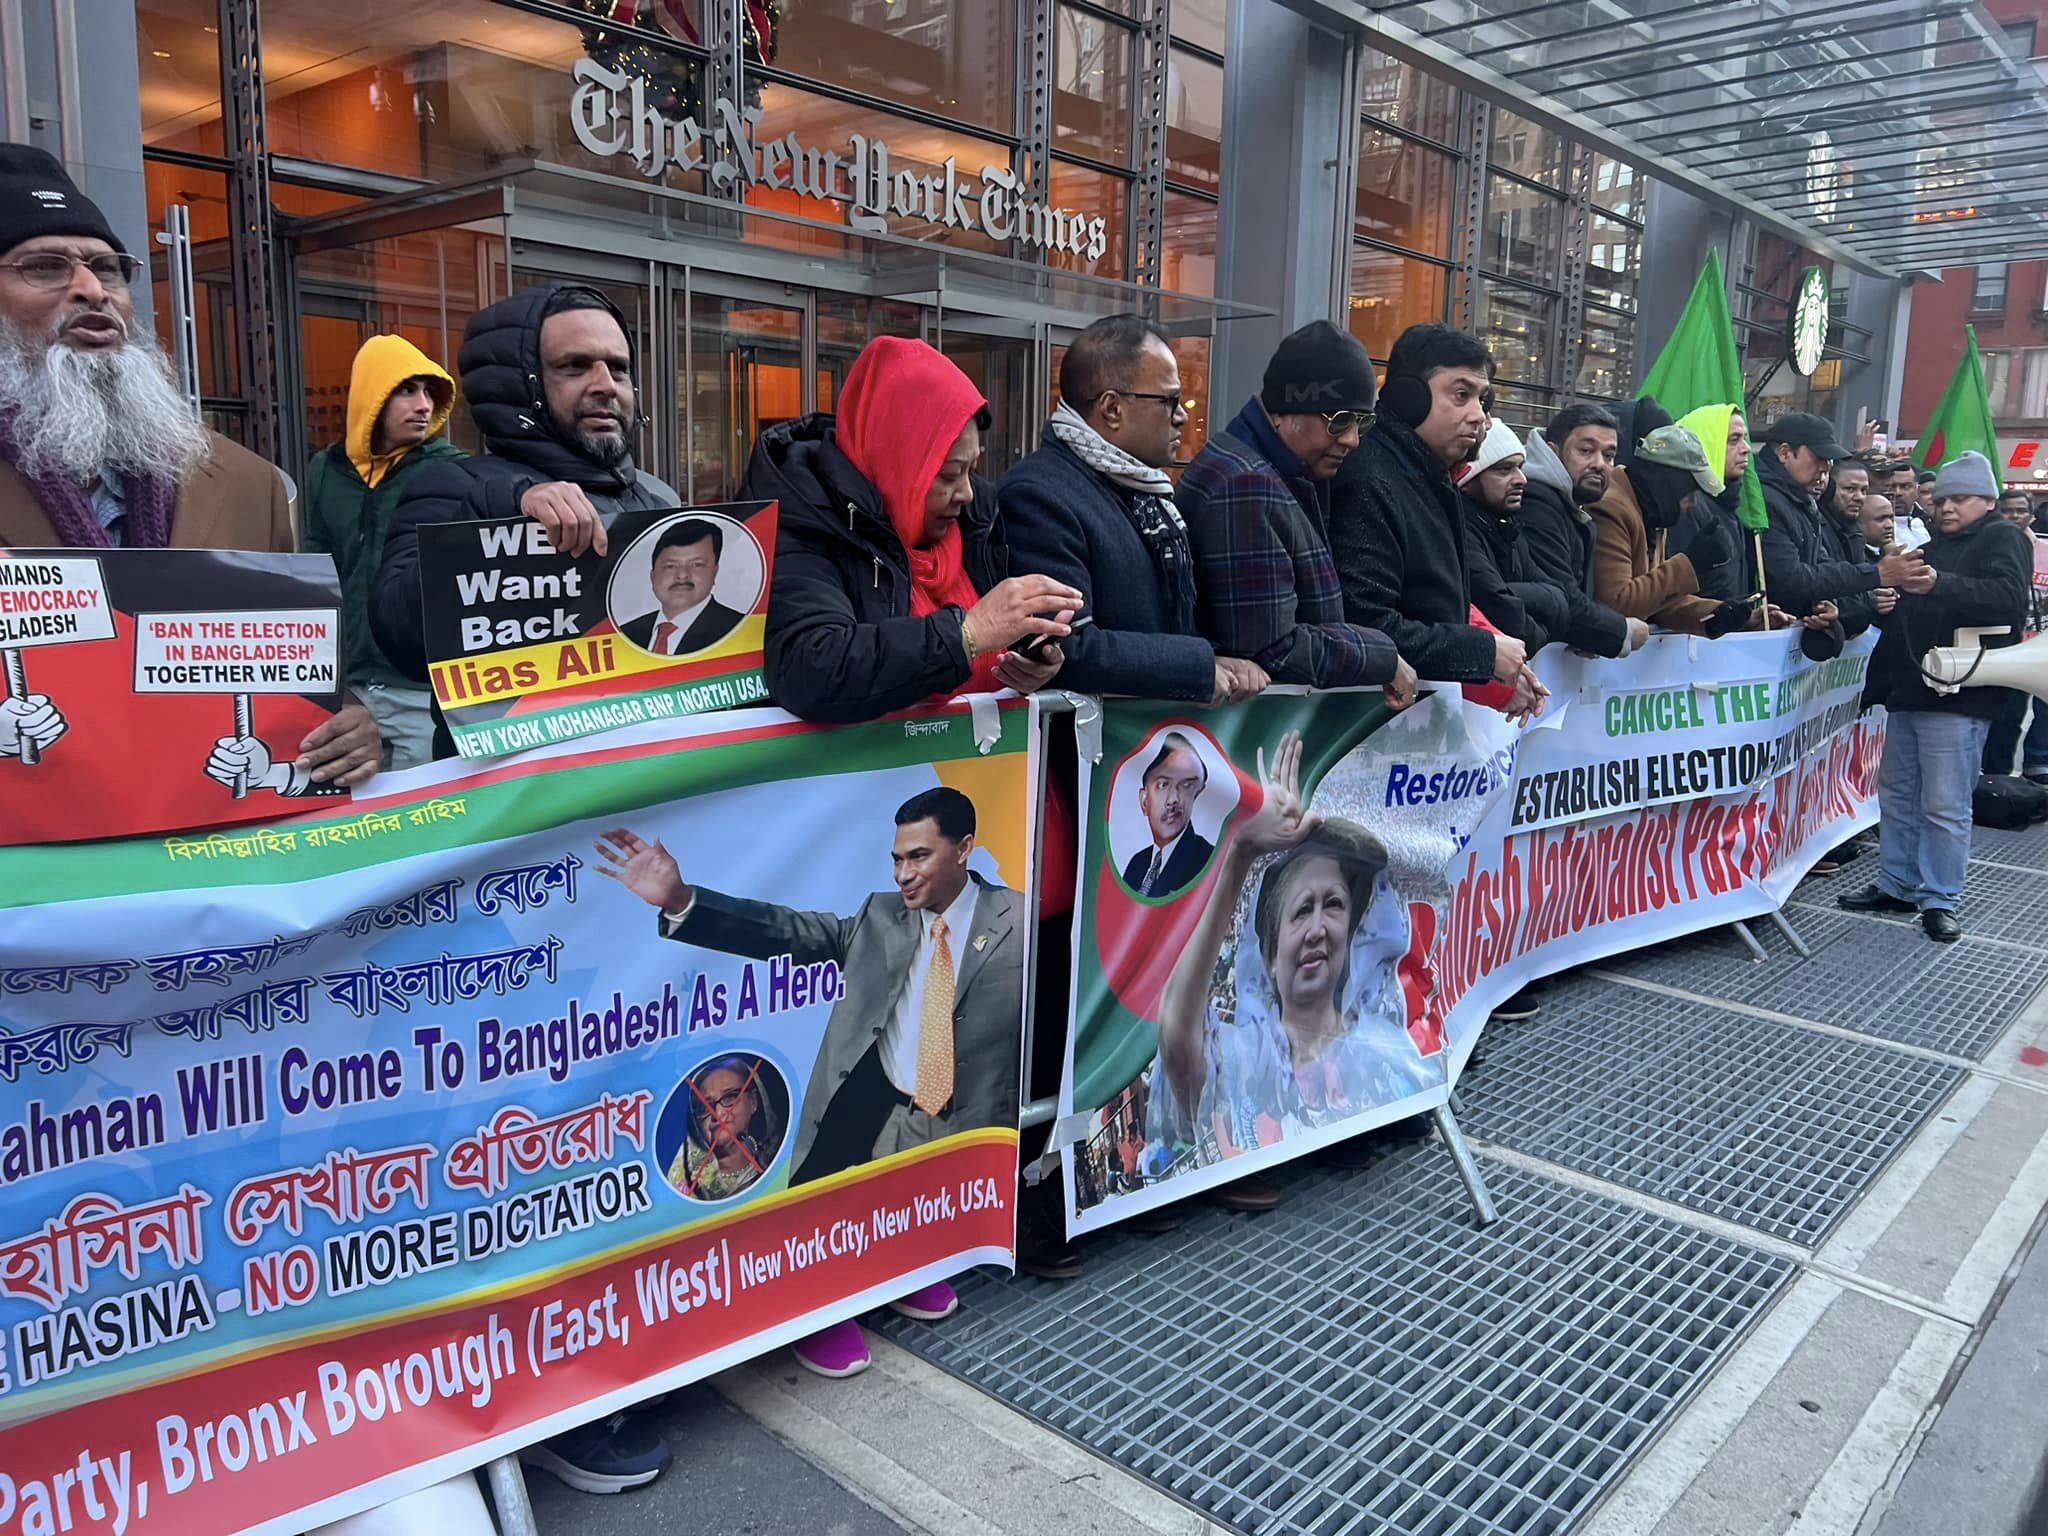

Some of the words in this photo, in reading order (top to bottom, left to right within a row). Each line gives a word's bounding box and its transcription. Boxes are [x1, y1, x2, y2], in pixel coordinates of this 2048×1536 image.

[571, 57, 702, 177] The
[711, 97, 843, 200] New
[849, 134, 976, 234] York
[979, 165, 1108, 263] Times
[479, 521, 556, 558] WE
[456, 566, 582, 606] Want
[165, 645, 186, 661] IN
[200, 622, 235, 639] THE
[241, 622, 327, 640] ELECTION
[461, 608, 581, 651] Back
[144, 665, 255, 684] TOGETHER
[261, 665, 290, 682] WE
[295, 664, 333, 682] CAN
[431, 661, 540, 704] Ilias
[556, 638, 617, 681] Ali
[455, 730, 495, 759] NEW
[494, 718, 547, 752] YORK
[548, 701, 645, 739] MOHANAGAR
[646, 695, 674, 719] BNP
[676, 681, 736, 717] (NORTH)
[738, 675, 770, 701] USA.
[1605, 690, 1704, 737] CANCEL
[1710, 683, 1770, 725] THE
[1385, 761, 1488, 808] Restore
[1511, 757, 1640, 828] ESTABLISH
[163, 831, 296, 862] বিসমিল্লাহির
[303, 813, 402, 847] রাহমানির
[406, 797, 467, 829] রাহিম
[1517, 804, 1681, 957] Nationalist
[0, 959, 139, 994] রেক
[474, 853, 583, 917] বেশে
[320, 934, 564, 1017] বাংলাদেশে
[0, 1091, 164, 1185] ahman
[178, 1053, 265, 1135] Will
[280, 1047, 402, 1115] Come
[414, 1027, 464, 1091] To
[479, 984, 679, 1083] Bangladesh
[689, 974, 727, 1031] As
[737, 963, 759, 1019] A
[769, 954, 845, 1013] Hero.
[227, 1147, 434, 1238] সেখানে
[20, 1279, 210, 1381] HASINA
[248, 1250, 315, 1312] NO
[329, 1217, 454, 1291] MORE
[469, 1165, 648, 1257] DICTATOR
[157, 1391, 316, 1494] Bronx
[318, 1314, 516, 1436] Borough
[528, 1284, 631, 1377] (East,
[740, 1247, 781, 1288] New
[784, 1231, 827, 1276] York
[830, 1219, 870, 1259] City,
[873, 1205, 909, 1242] New
[914, 1185, 957, 1226] York,
[959, 1176, 1005, 1213] USA.
